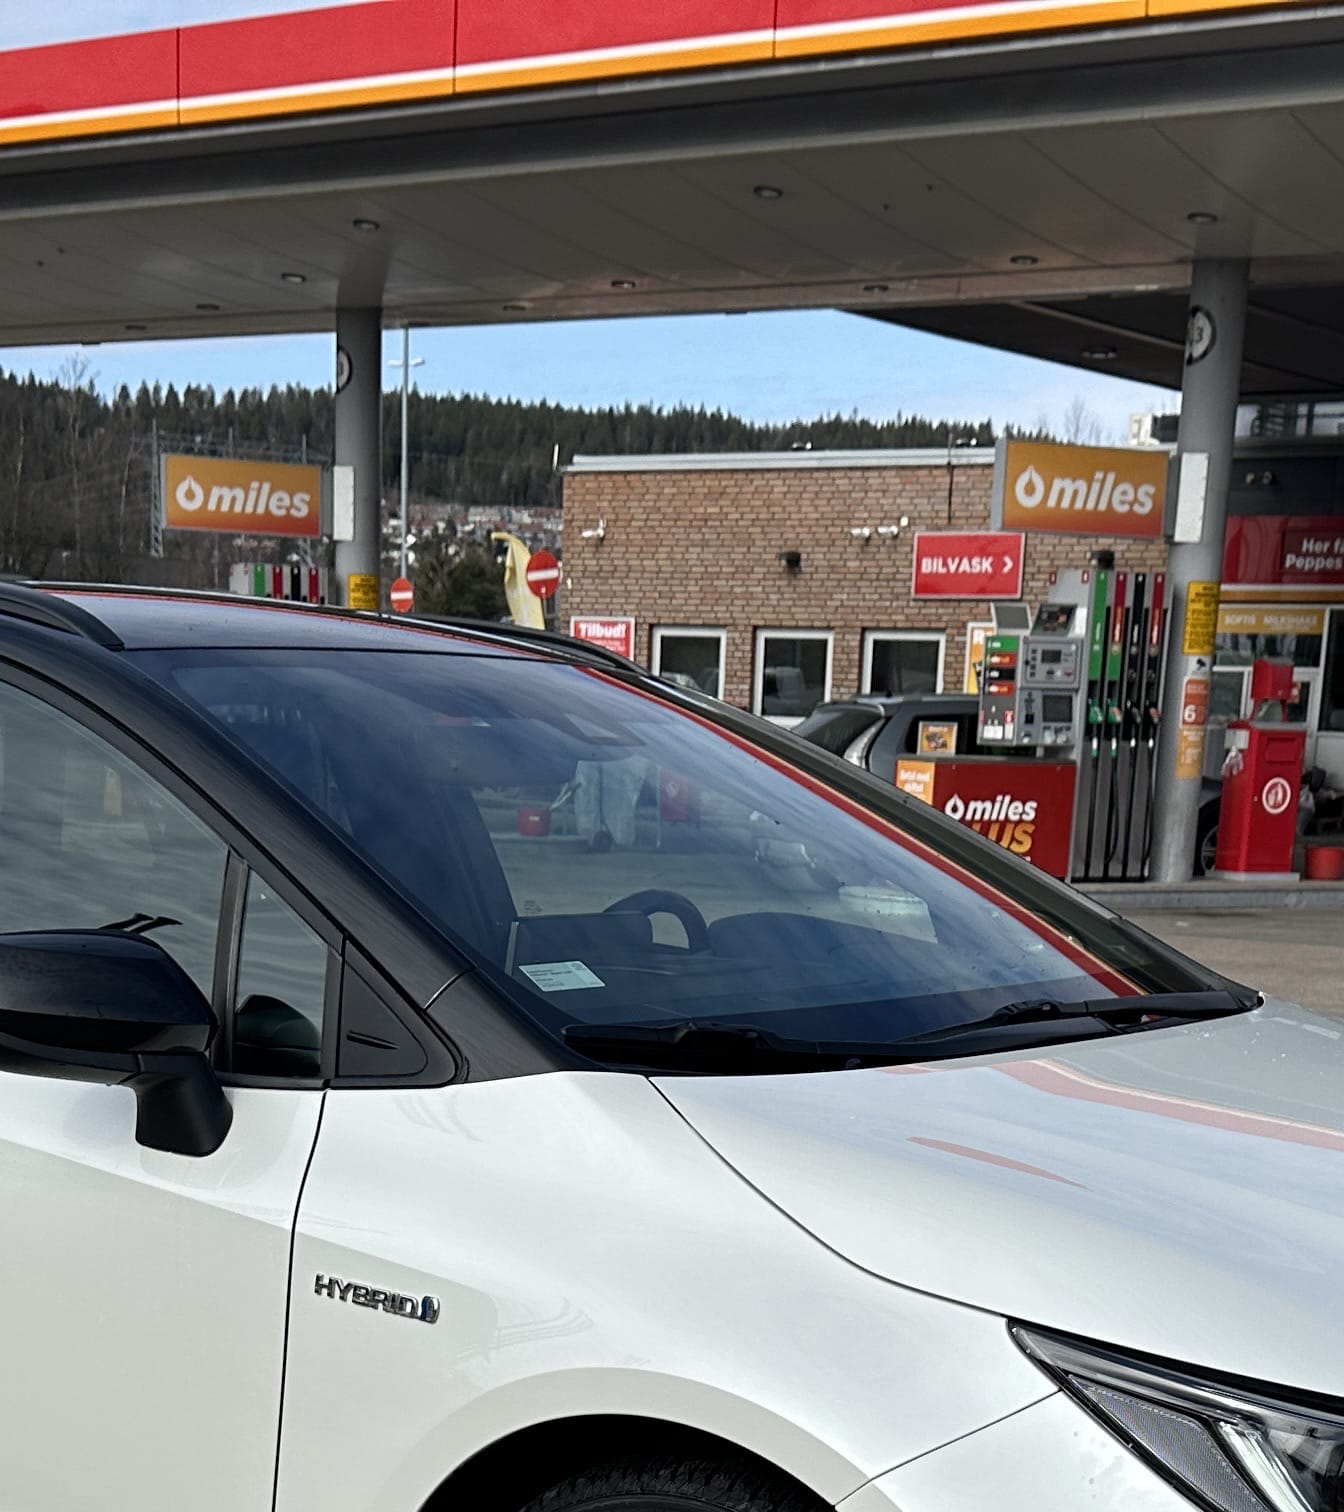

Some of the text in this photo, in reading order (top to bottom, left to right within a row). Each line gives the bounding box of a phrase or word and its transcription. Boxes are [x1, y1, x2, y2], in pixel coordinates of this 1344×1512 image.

[207, 480, 311, 518] miles
[1047, 470, 1155, 515] miles
[1301, 538, 1330, 553] Her
[921, 556, 993, 574] BILVASK
[1285, 553, 1343, 571] Peppes
[578, 623, 627, 638] Tilbud!
[965, 795, 1038, 822] miles
[314, 1273, 420, 1320] HYBRID
